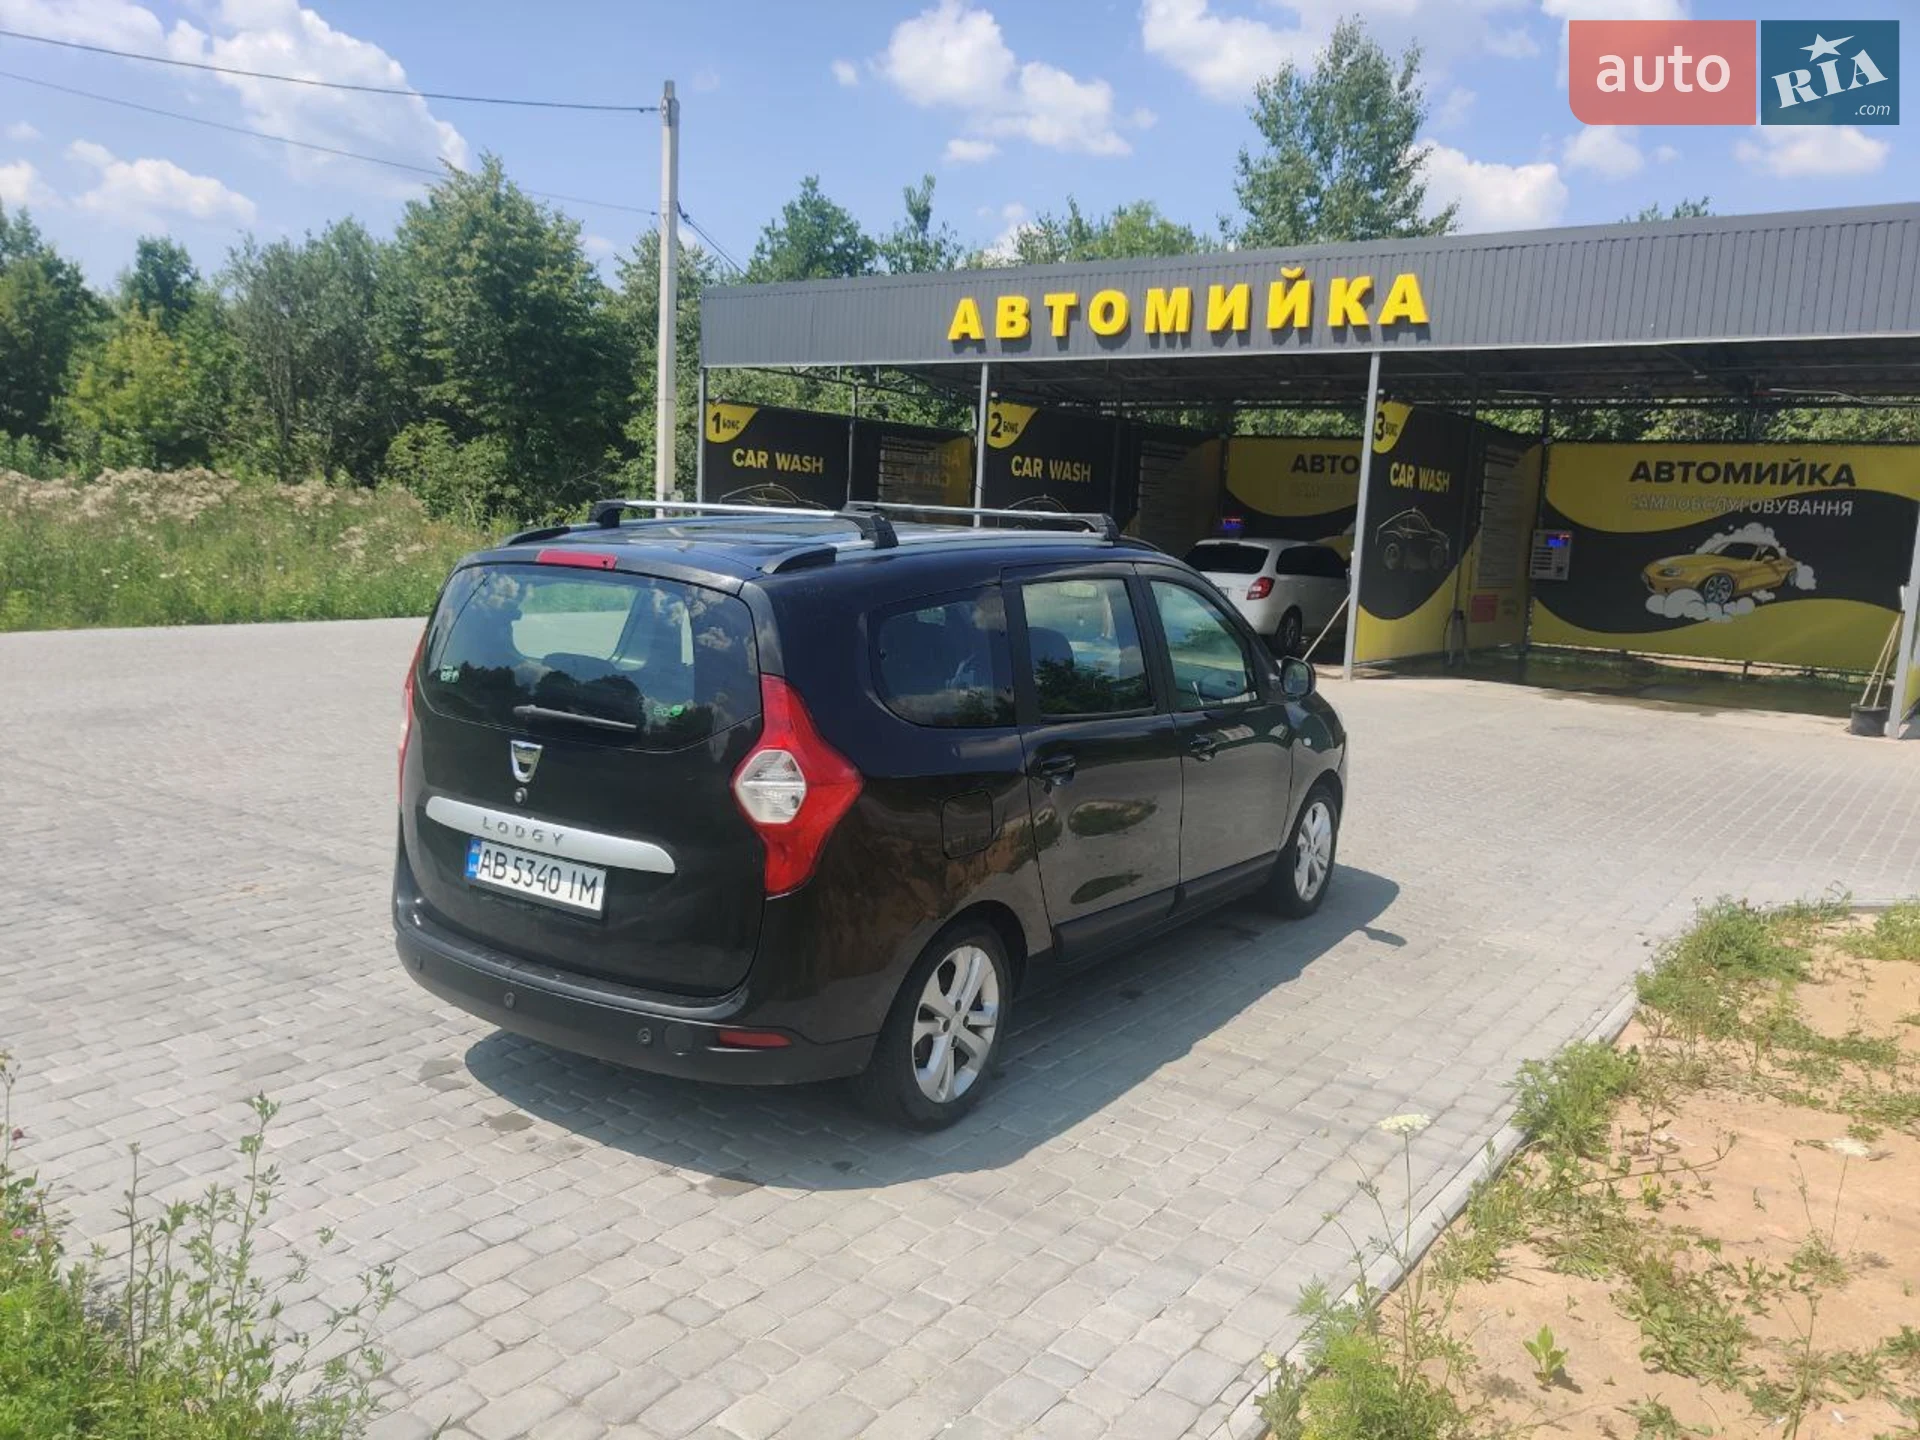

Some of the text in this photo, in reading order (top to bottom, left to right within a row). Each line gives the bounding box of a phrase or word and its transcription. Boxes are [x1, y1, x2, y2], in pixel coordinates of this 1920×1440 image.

[947, 266, 1430, 340] АВТОМИЙКА
[712, 412, 721, 434] 1
[990, 412, 1003, 439] 2
[1375, 411, 1386, 441] 3
[732, 447, 824, 473] CAR WASH
[1011, 455, 1092, 483] CAR WASH
[1629, 458, 1857, 487] АВТОМИЙКА
[1390, 461, 1451, 493] CAR WASH
[482, 816, 566, 847] LODGY
[480, 849, 599, 904] AB 5340 IM
